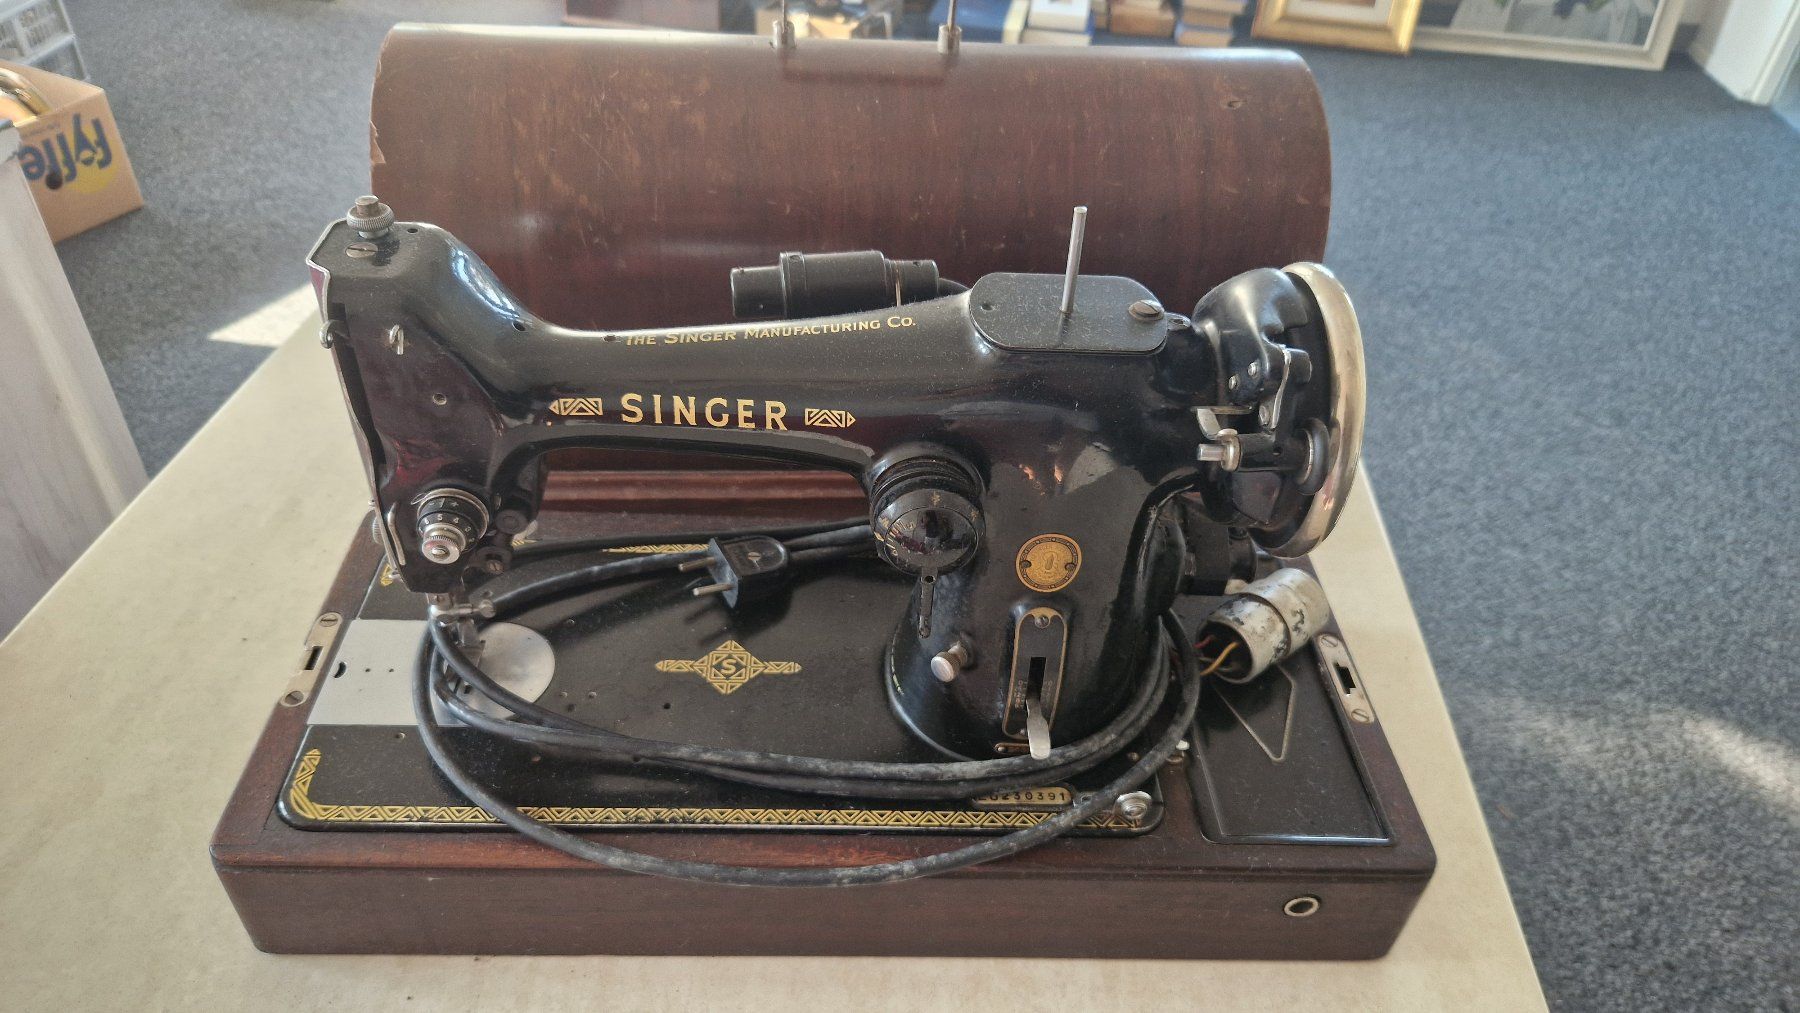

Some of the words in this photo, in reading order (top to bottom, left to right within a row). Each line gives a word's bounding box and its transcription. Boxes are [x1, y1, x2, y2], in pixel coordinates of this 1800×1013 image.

[625, 334, 657, 346] THE
[665, 331, 736, 344] SINGER
[744, 319, 880, 338] MANUFACTURING
[621, 393, 788, 431] SINGER
[437, 513, 443, 521] 5
[721, 658, 737, 674] S
[978, 791, 1065, 801] 230391
